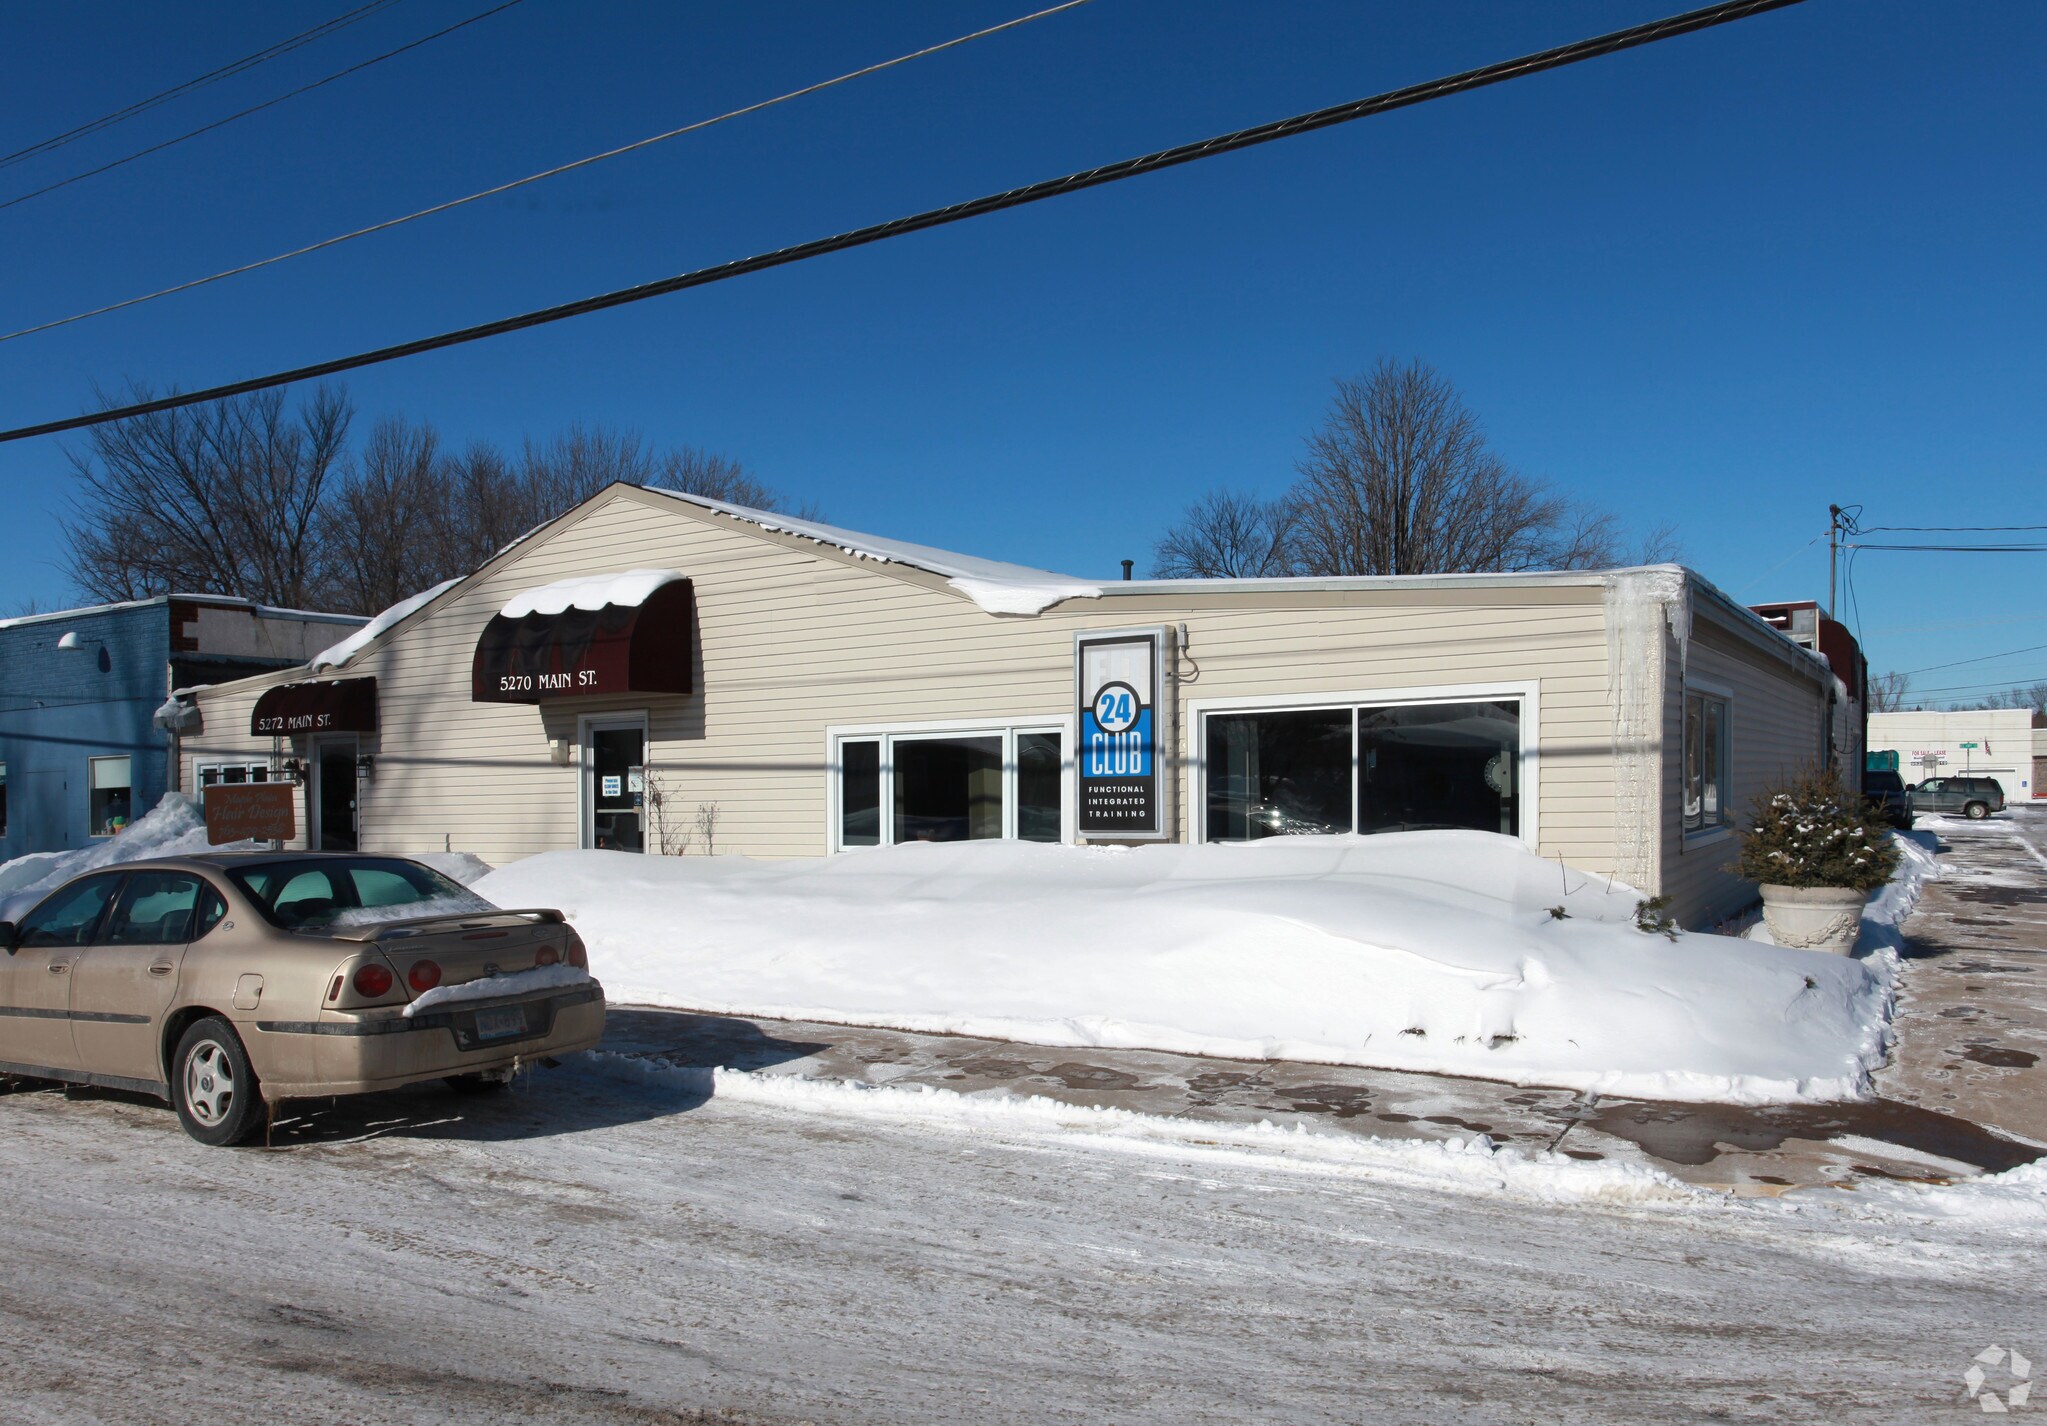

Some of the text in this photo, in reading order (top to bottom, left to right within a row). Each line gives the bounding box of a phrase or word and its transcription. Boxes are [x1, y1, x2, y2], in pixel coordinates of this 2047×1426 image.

[500, 670, 597, 691] 5270 MAIN ST.
[1100, 694, 1131, 724] 24
[258, 713, 332, 731] 5272 MAIN ST.
[1092, 731, 1142, 775] CLUB
[212, 804, 289, 825] Hair Design
[1088, 810, 1146, 818] TRAINING
